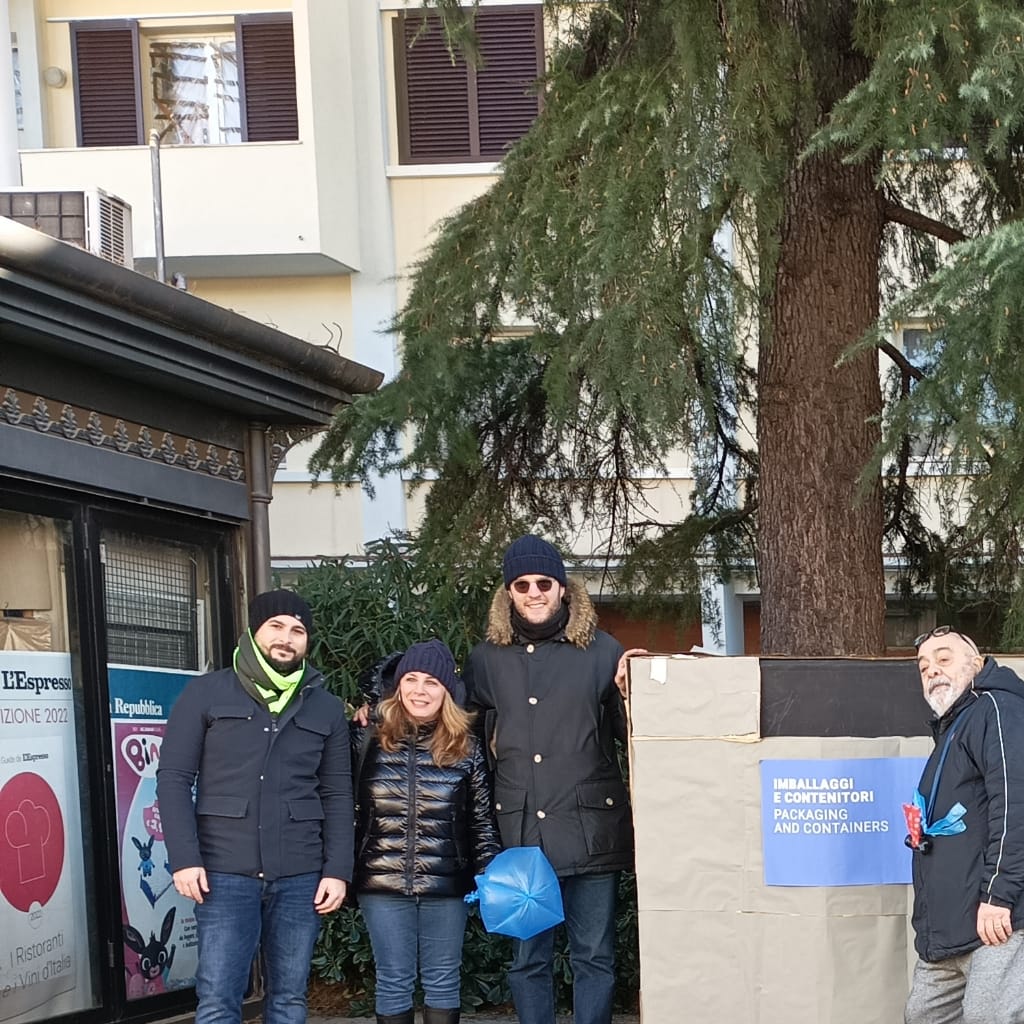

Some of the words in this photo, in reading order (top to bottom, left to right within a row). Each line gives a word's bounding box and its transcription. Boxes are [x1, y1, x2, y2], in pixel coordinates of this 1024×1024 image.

[1, 670, 72, 695] L'Espresso
[0, 707, 41, 724] IZIONE
[44, 707, 68, 724] 2022
[114, 697, 163, 717] Repubblica
[125, 737, 160, 772] Bin
[773, 778, 854, 790] IMBALLAGGI
[773, 792, 781, 804] E
[784, 791, 874, 804] CONTENITORI
[773, 808, 849, 820] PACKAGING
[773, 822, 800, 834] AND
[803, 820, 889, 834] CONTAINERS
[10, 951, 14, 968] I
[15, 932, 64, 966] Ristoranti
[18, 970, 40, 990] Vini
[42, 954, 72, 981] d'Italia
